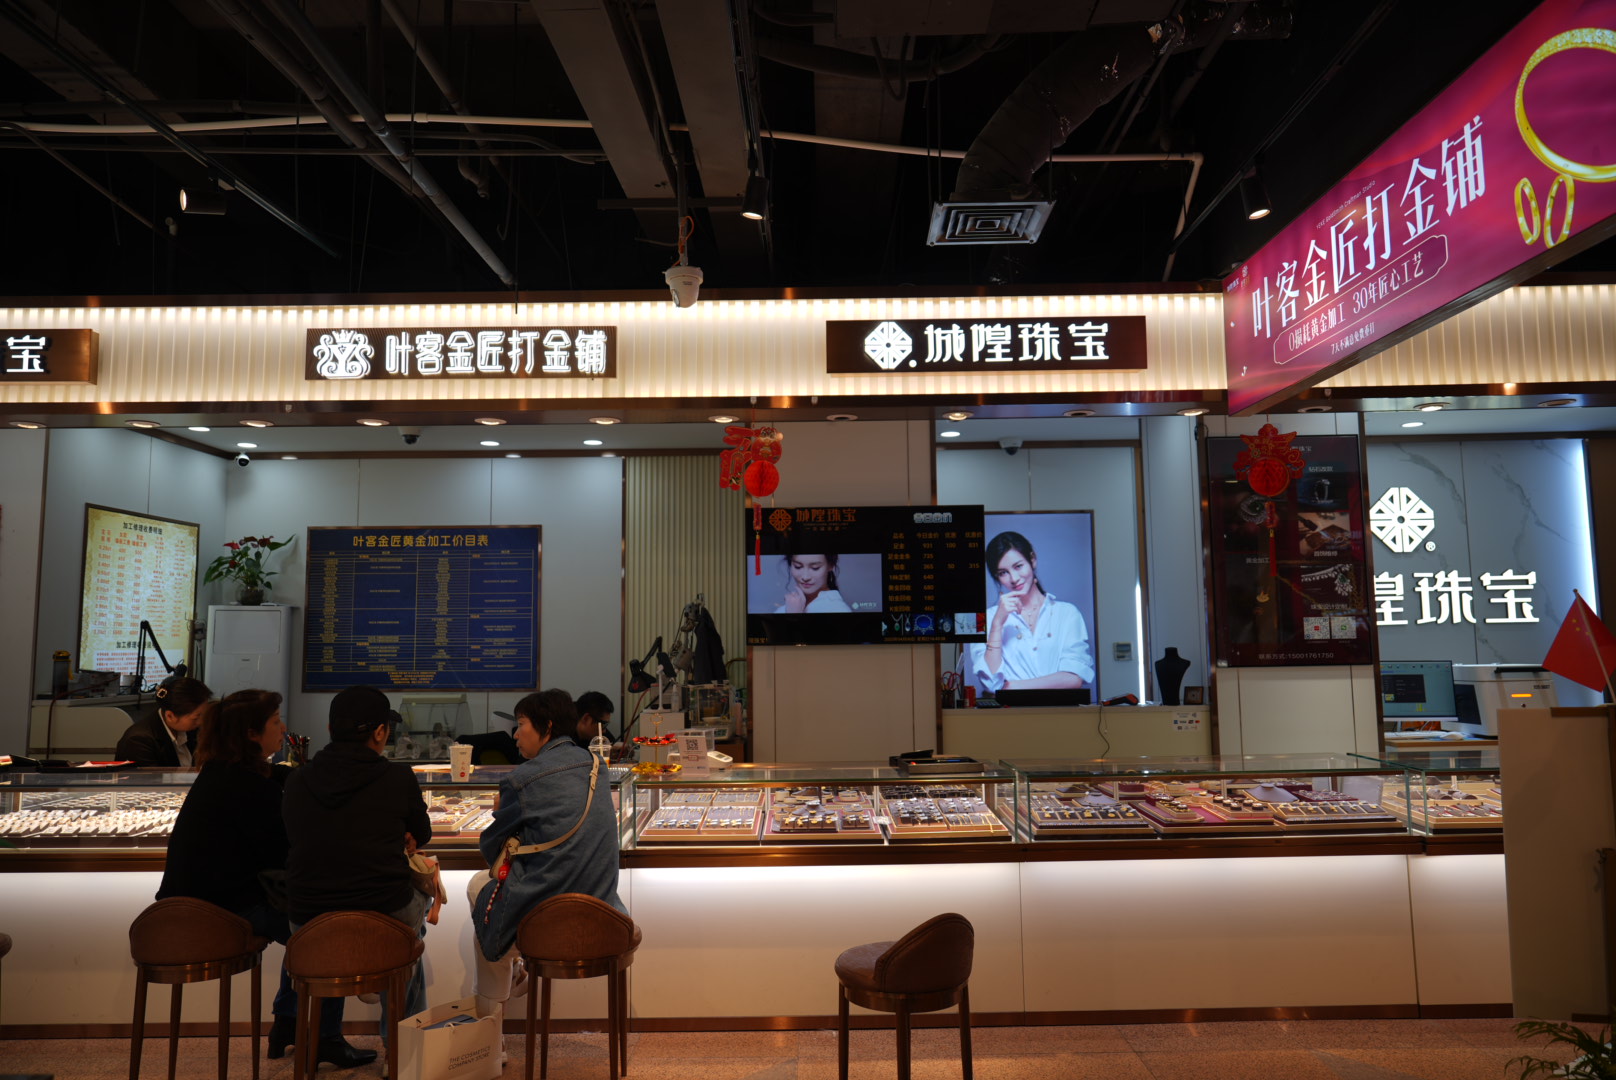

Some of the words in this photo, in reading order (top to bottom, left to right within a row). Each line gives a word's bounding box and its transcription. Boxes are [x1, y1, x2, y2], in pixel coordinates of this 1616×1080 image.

[1251, 115, 1486, 338] 叶客金匠打金铺
[1353, 251, 1425, 314] 30年匠心工艺
[6, 335, 46, 372] 宝
[385, 329, 607, 375] 叶客金匠打金铺
[924, 322, 1109, 363] 城隍珠宝
[122, 522, 164, 536] 加工修理收费明细
[796, 509, 857, 522] 城隍珠宝
[353, 535, 490, 548] 叶客金匠黄金加工价目表
